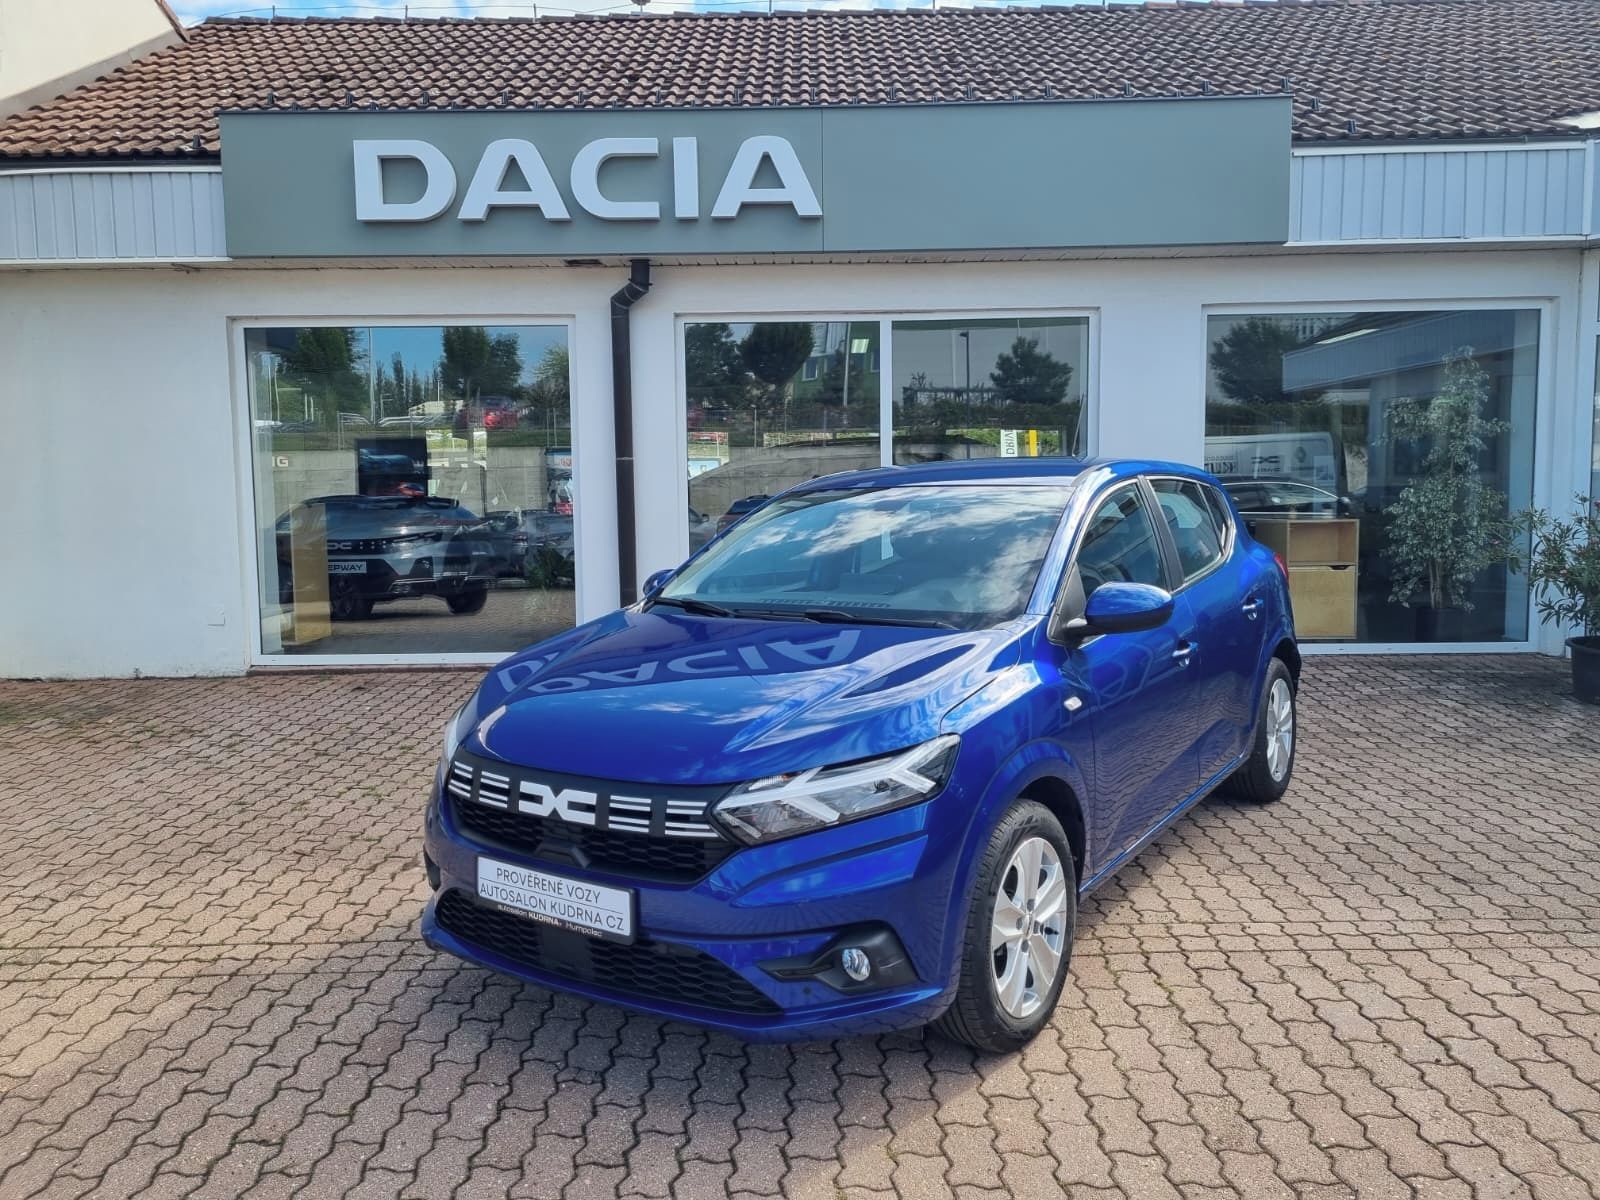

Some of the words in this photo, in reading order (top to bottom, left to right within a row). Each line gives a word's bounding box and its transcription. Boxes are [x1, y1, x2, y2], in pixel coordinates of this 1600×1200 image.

[353, 135, 823, 222] DACIA
[480, 883, 547, 911] AUTOSALON
[550, 901, 603, 926] KUDRNA
[606, 915, 625, 931] CZ
[566, 884, 601, 904] VOZY
